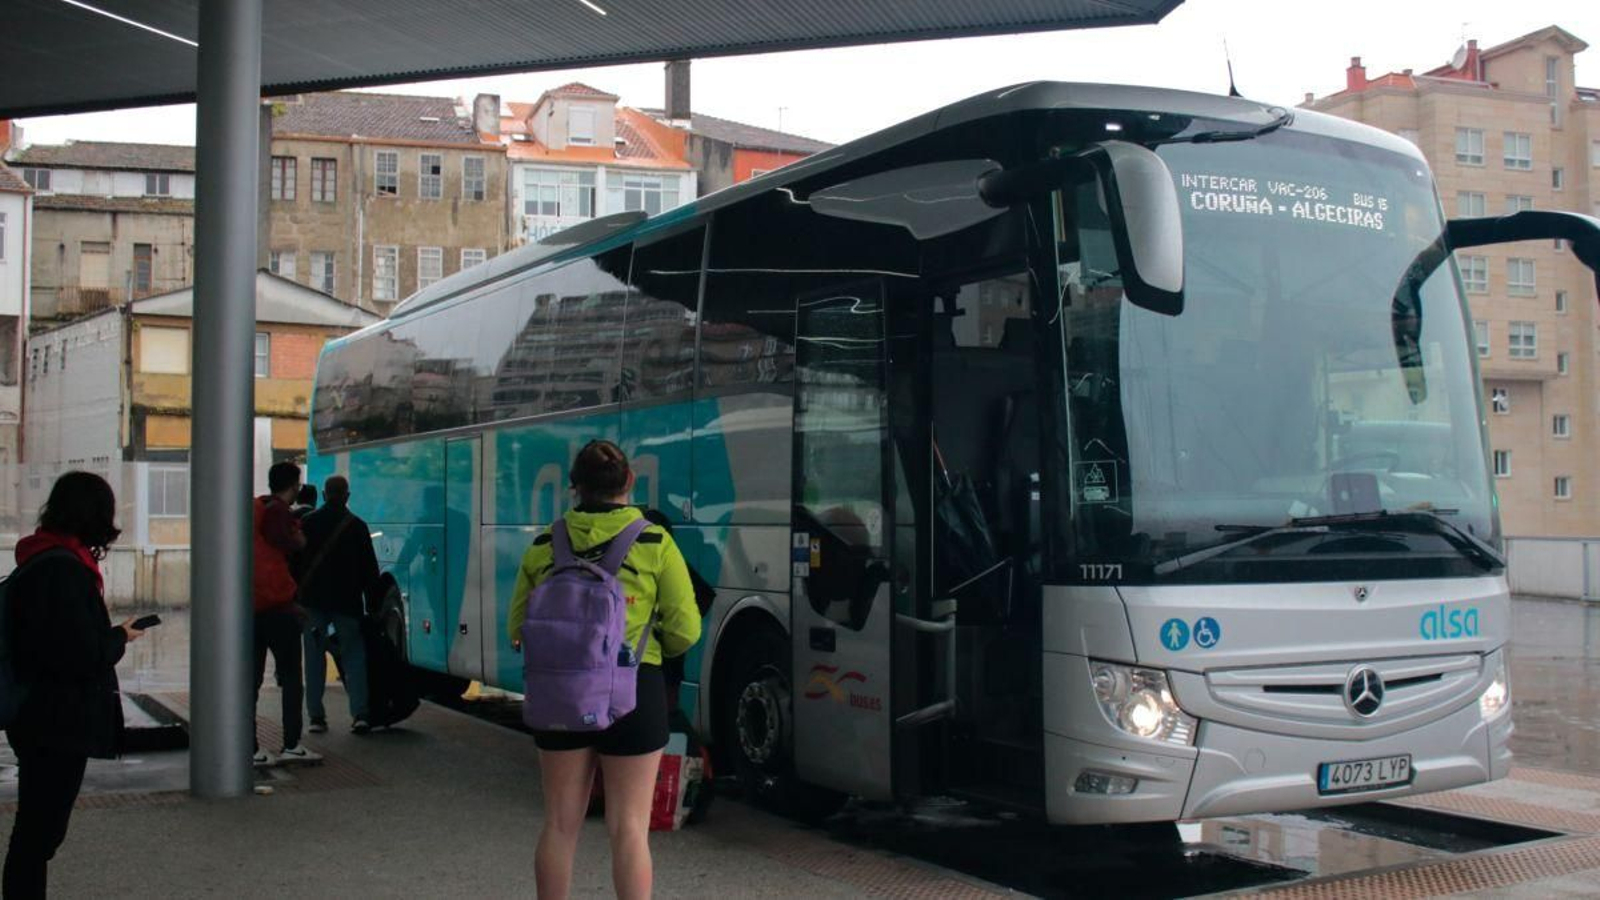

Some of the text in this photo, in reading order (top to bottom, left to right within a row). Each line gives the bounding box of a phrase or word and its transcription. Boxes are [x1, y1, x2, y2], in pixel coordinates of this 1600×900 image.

[1181, 173, 1388, 211] INTERCAR VAC-206 BUS 15
[1190, 191, 1273, 216] CORUÑA
[1291, 200, 1384, 230] ALGECIRAS
[1079, 563, 1123, 581] 11171
[1420, 604, 1479, 640] alsa
[1331, 758, 1408, 785] 4073 LYP
